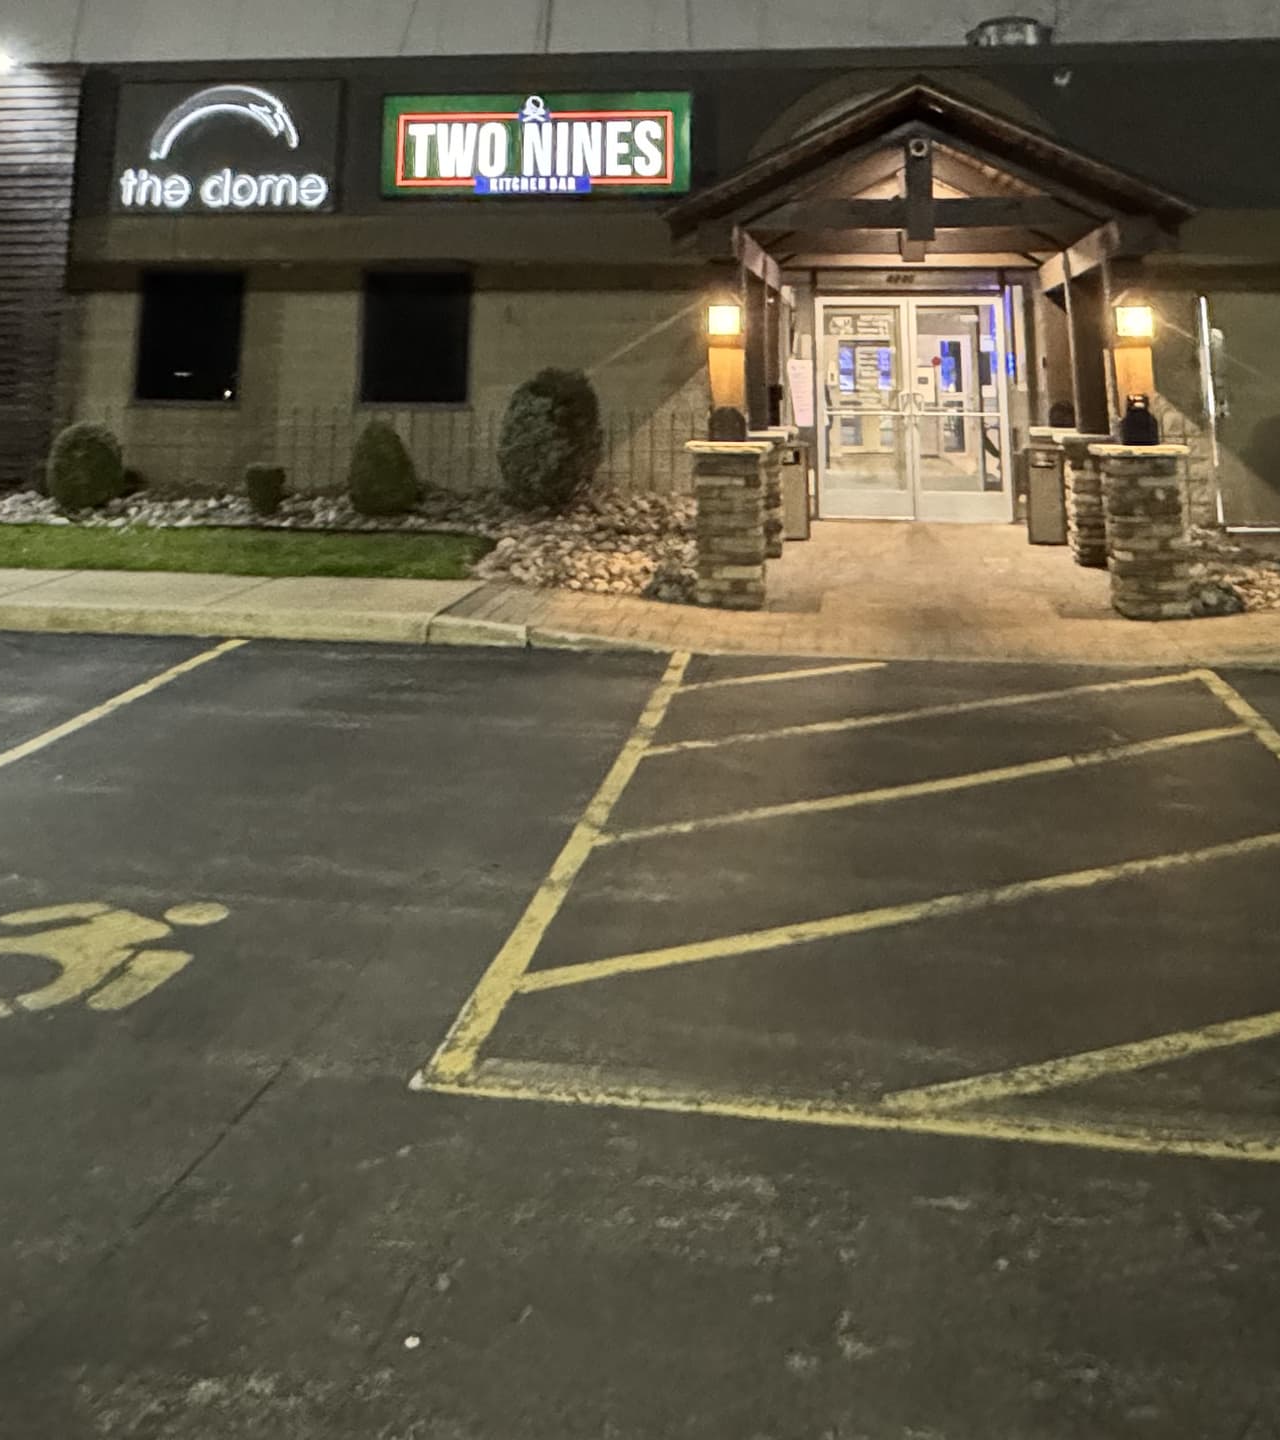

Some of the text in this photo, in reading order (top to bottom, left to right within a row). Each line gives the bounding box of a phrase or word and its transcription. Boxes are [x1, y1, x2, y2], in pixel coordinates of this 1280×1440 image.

[408, 120, 663, 178] TWO NINES
[120, 168, 328, 208] the dome
[490, 177, 576, 192] KITCHEN BAR
